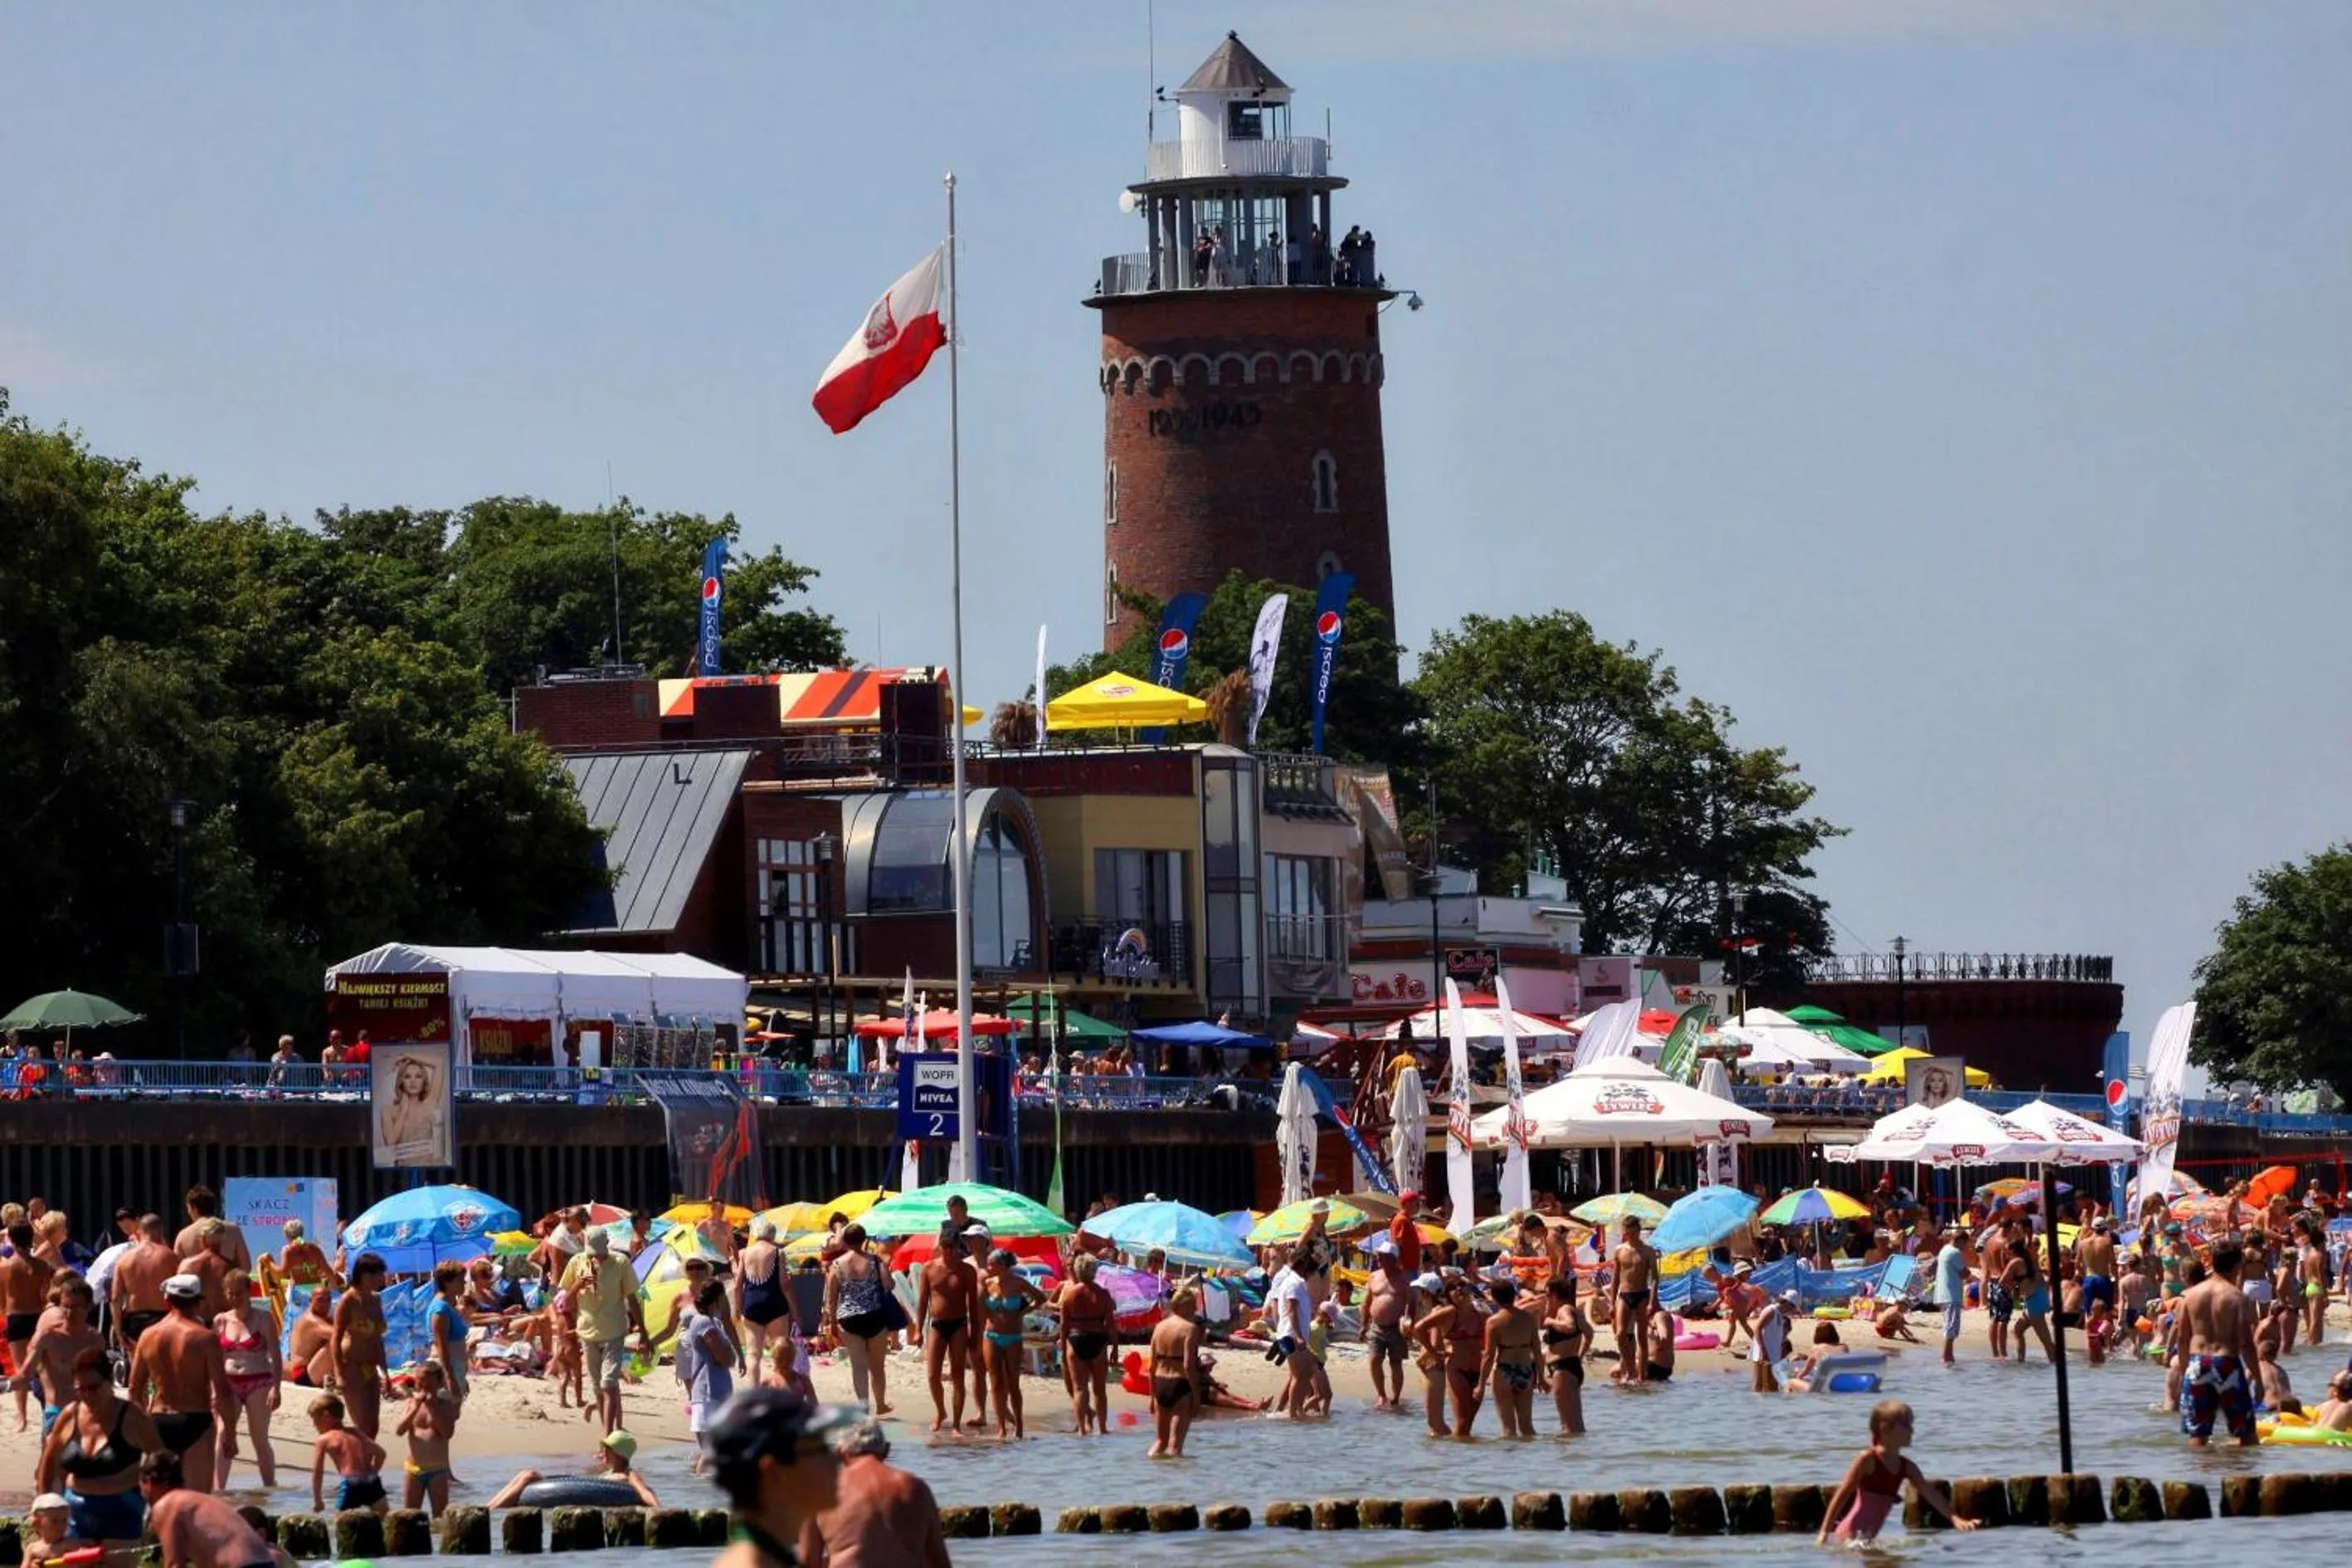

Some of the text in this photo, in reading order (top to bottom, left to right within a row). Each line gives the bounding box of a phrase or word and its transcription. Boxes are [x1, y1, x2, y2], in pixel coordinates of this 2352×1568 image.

[704, 611, 718, 669] pepsi
[1318, 647, 1334, 704] pepsi
[1351, 972, 1427, 1001] Cafe
[919, 1093, 954, 1103] NIVEA
[929, 1113, 944, 1136] 2
[248, 1199, 290, 1210] SKACZ
